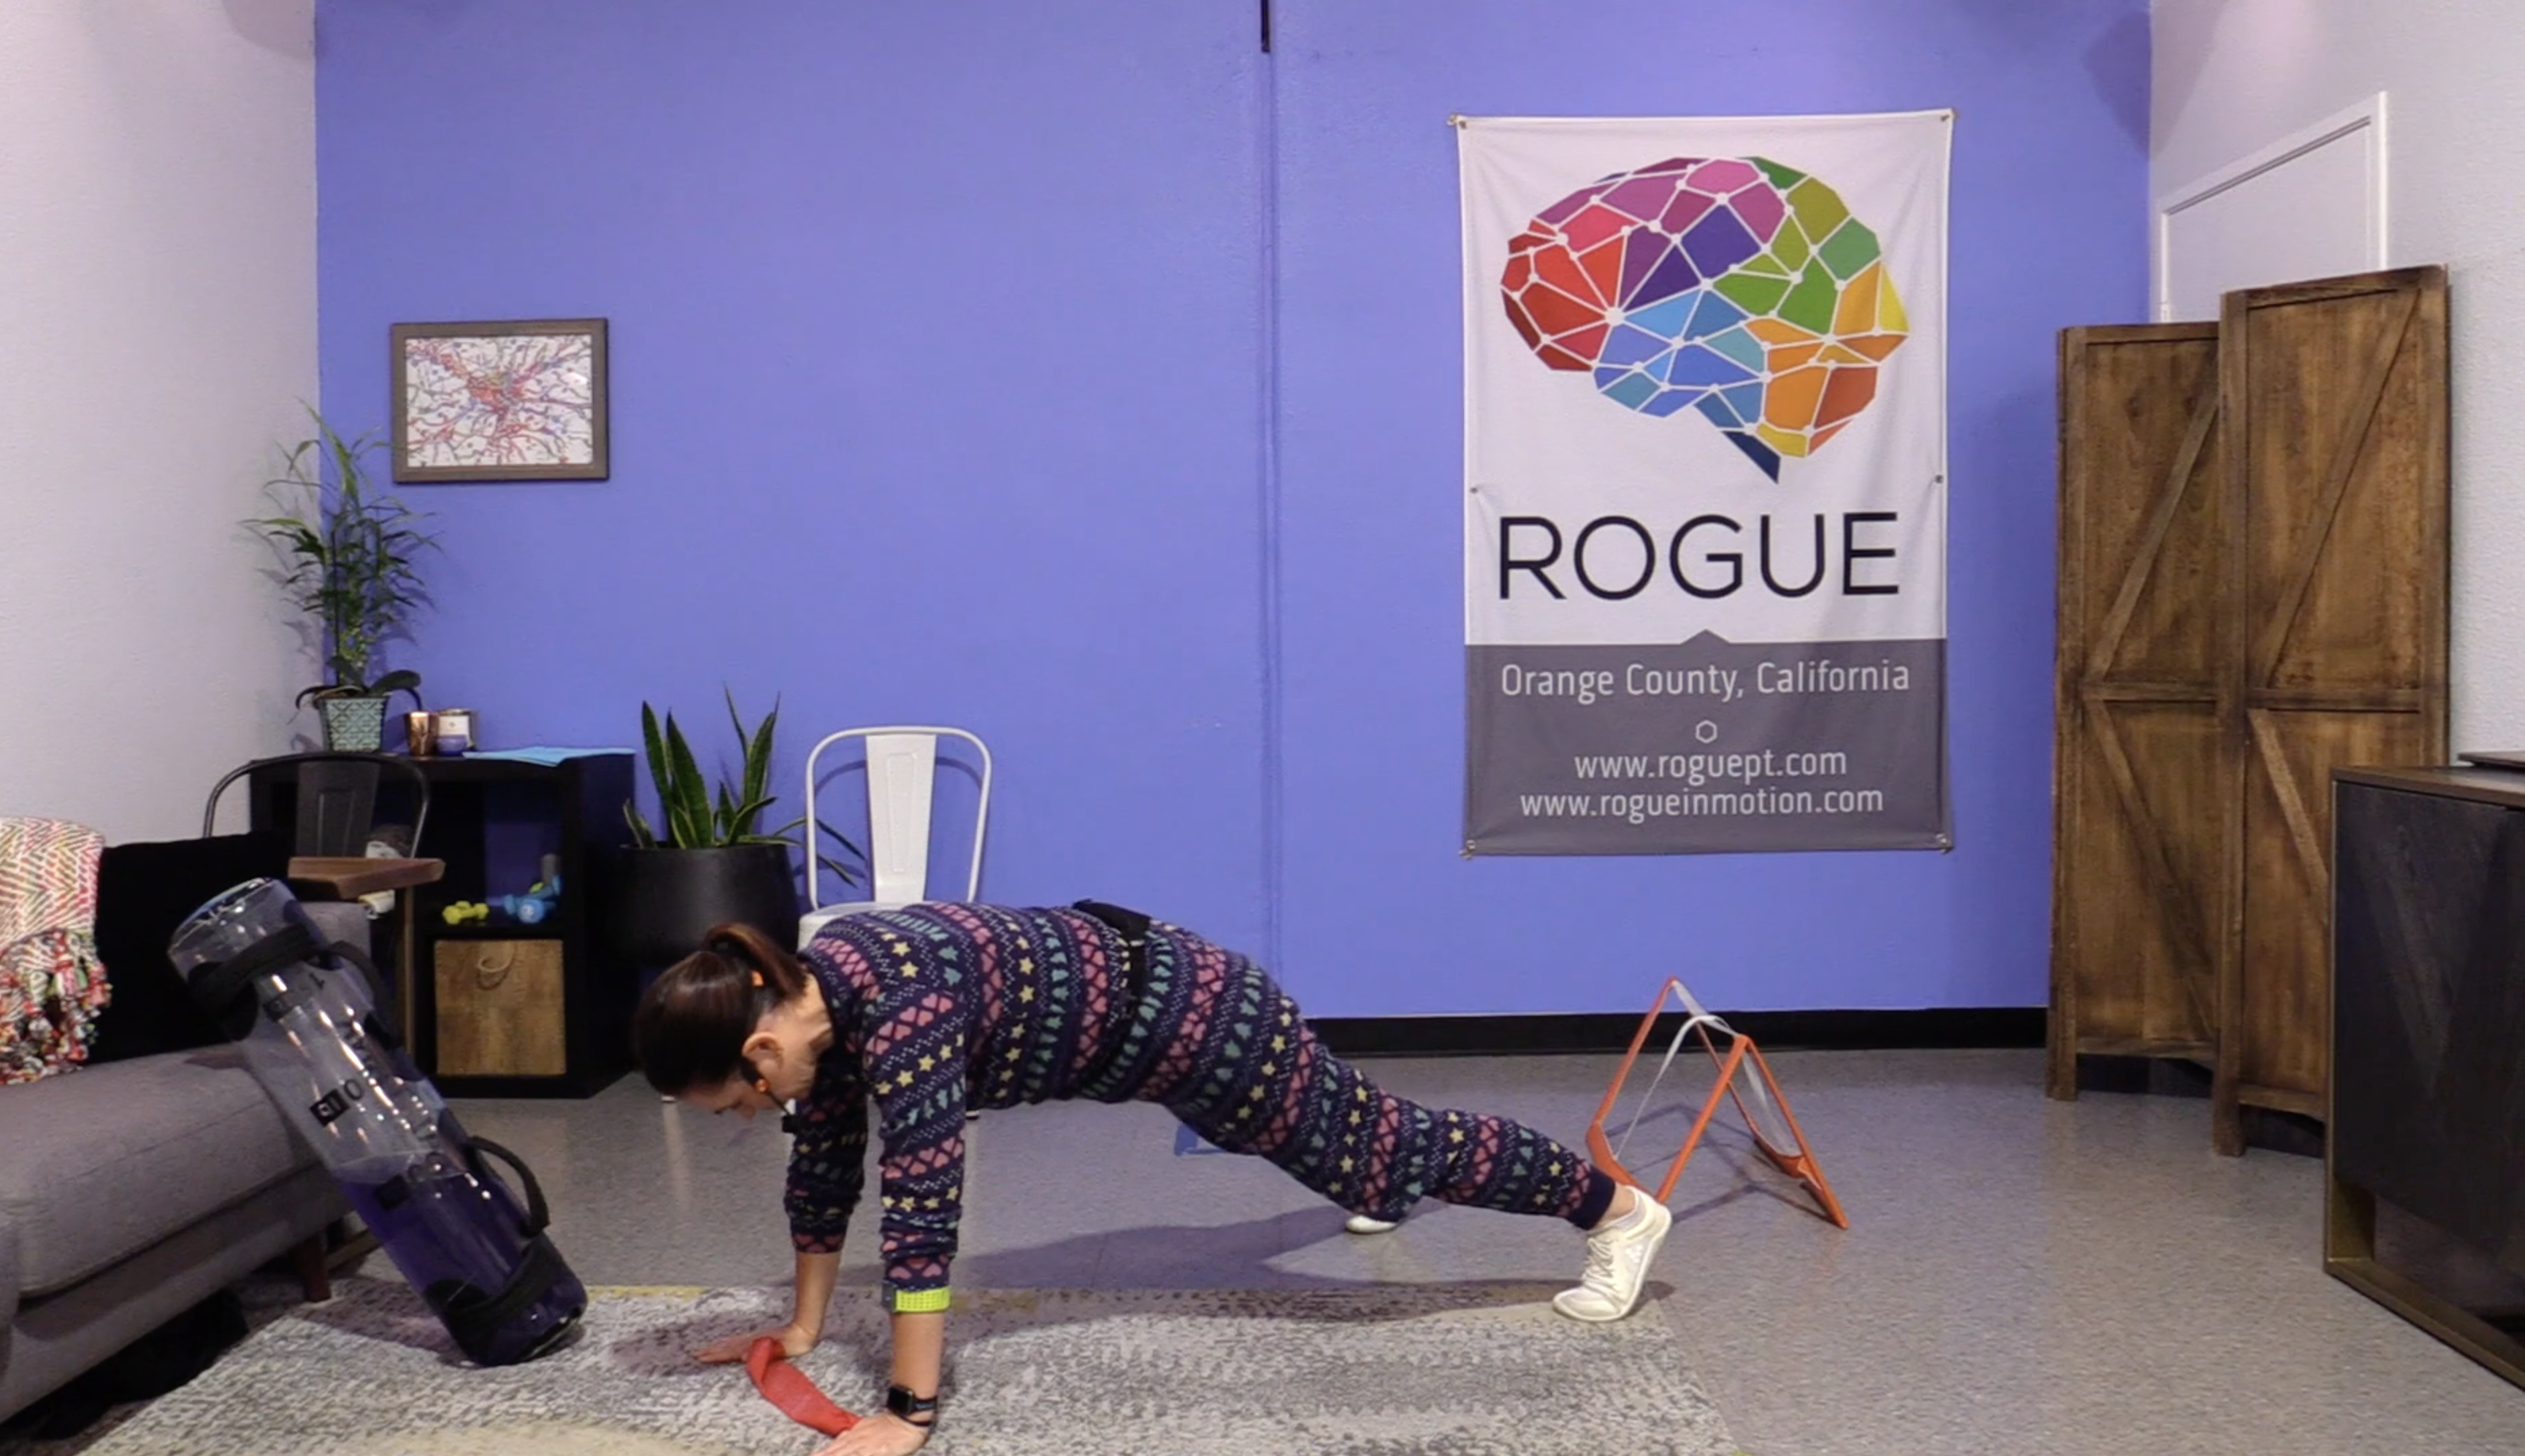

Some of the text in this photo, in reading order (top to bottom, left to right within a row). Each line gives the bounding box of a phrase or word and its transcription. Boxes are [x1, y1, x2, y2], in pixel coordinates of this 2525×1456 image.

[1499, 511, 1899, 601] ROGUE
[1501, 660, 1909, 705] Orange County, California
[1574, 750, 1847, 785] www.roguept.com
[1520, 786, 1883, 824] www.rogueinmotion.com
